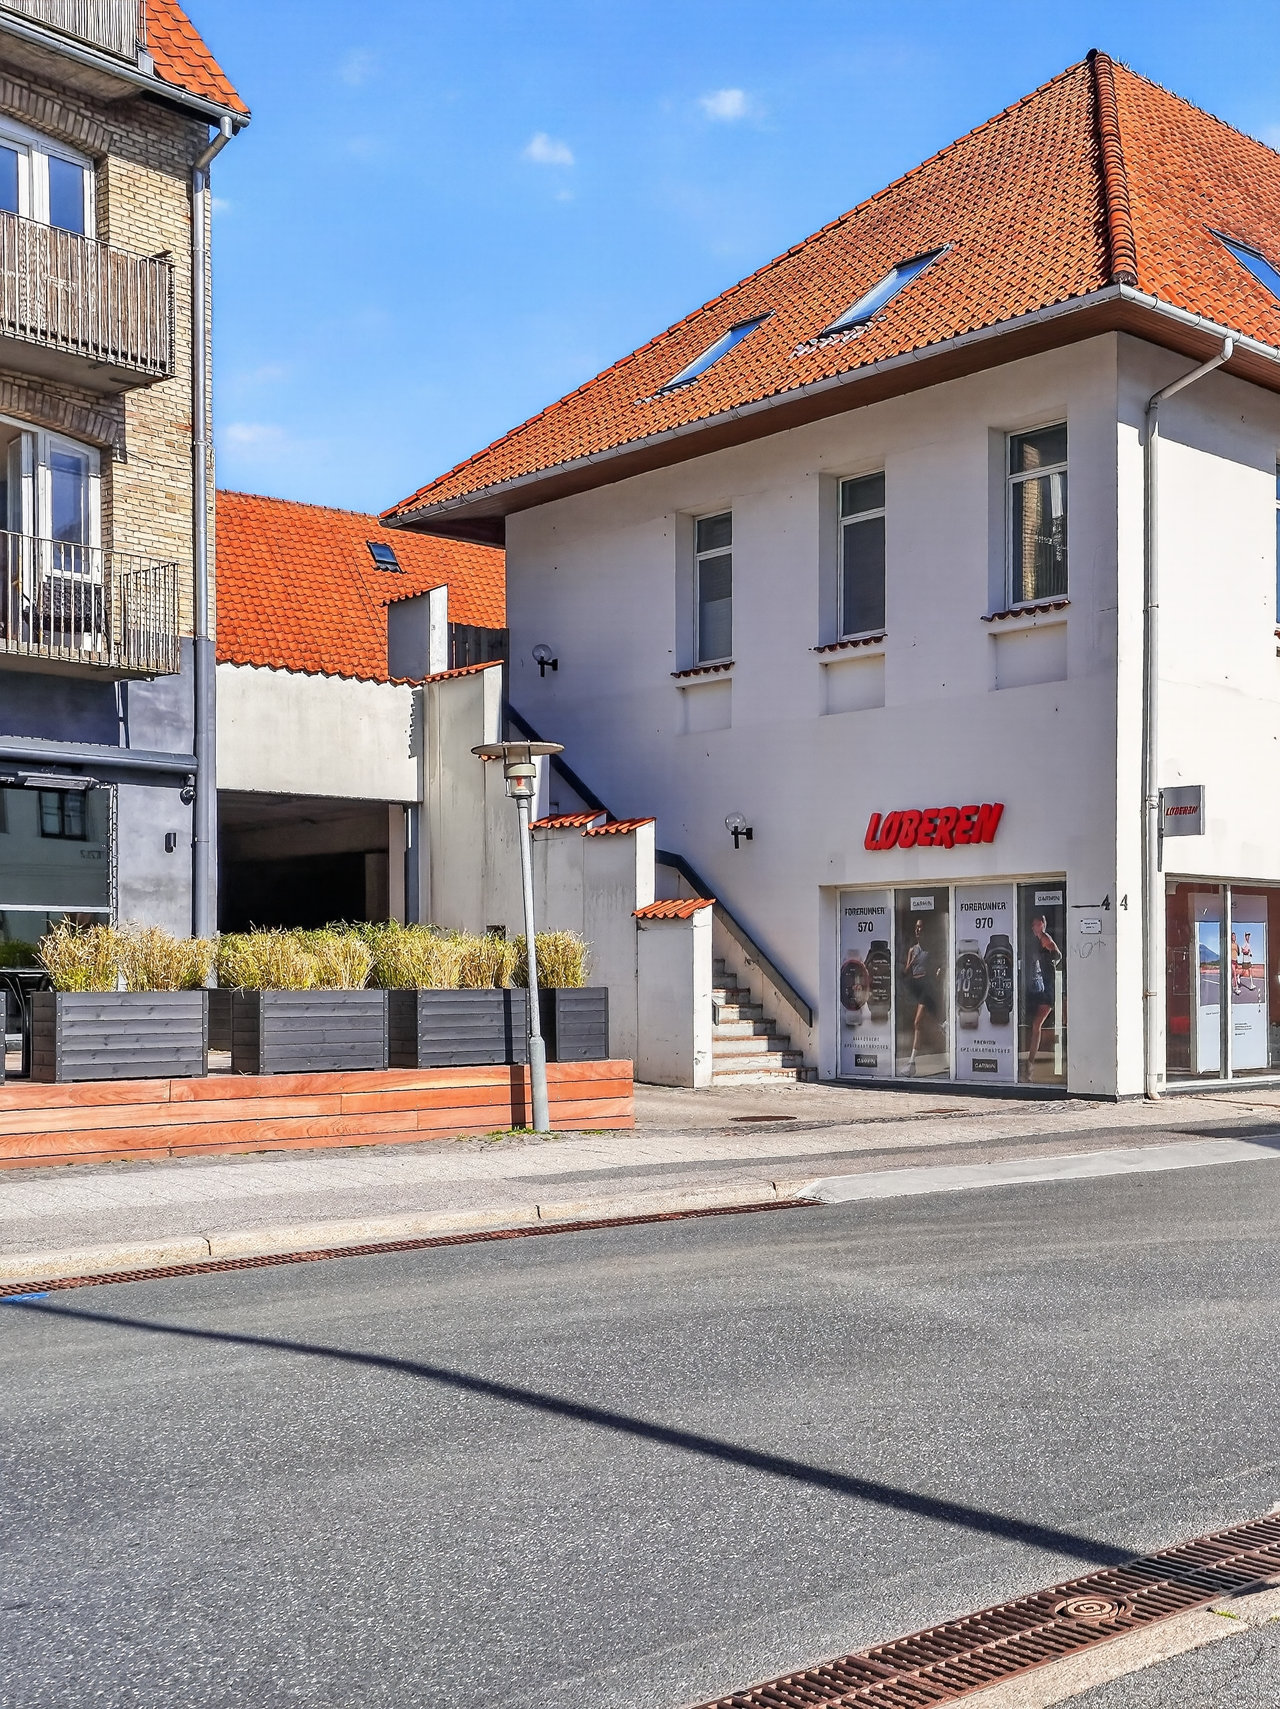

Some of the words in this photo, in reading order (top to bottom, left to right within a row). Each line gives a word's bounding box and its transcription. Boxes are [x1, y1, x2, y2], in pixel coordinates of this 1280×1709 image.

[864, 803, 1004, 850] LØBEREN
[960, 902, 1007, 911] FORERUNNER
[1101, 894, 1110, 911] 4
[1120, 894, 1128, 911] 4
[858, 921, 874, 932] 570
[975, 917, 993, 929] 970
